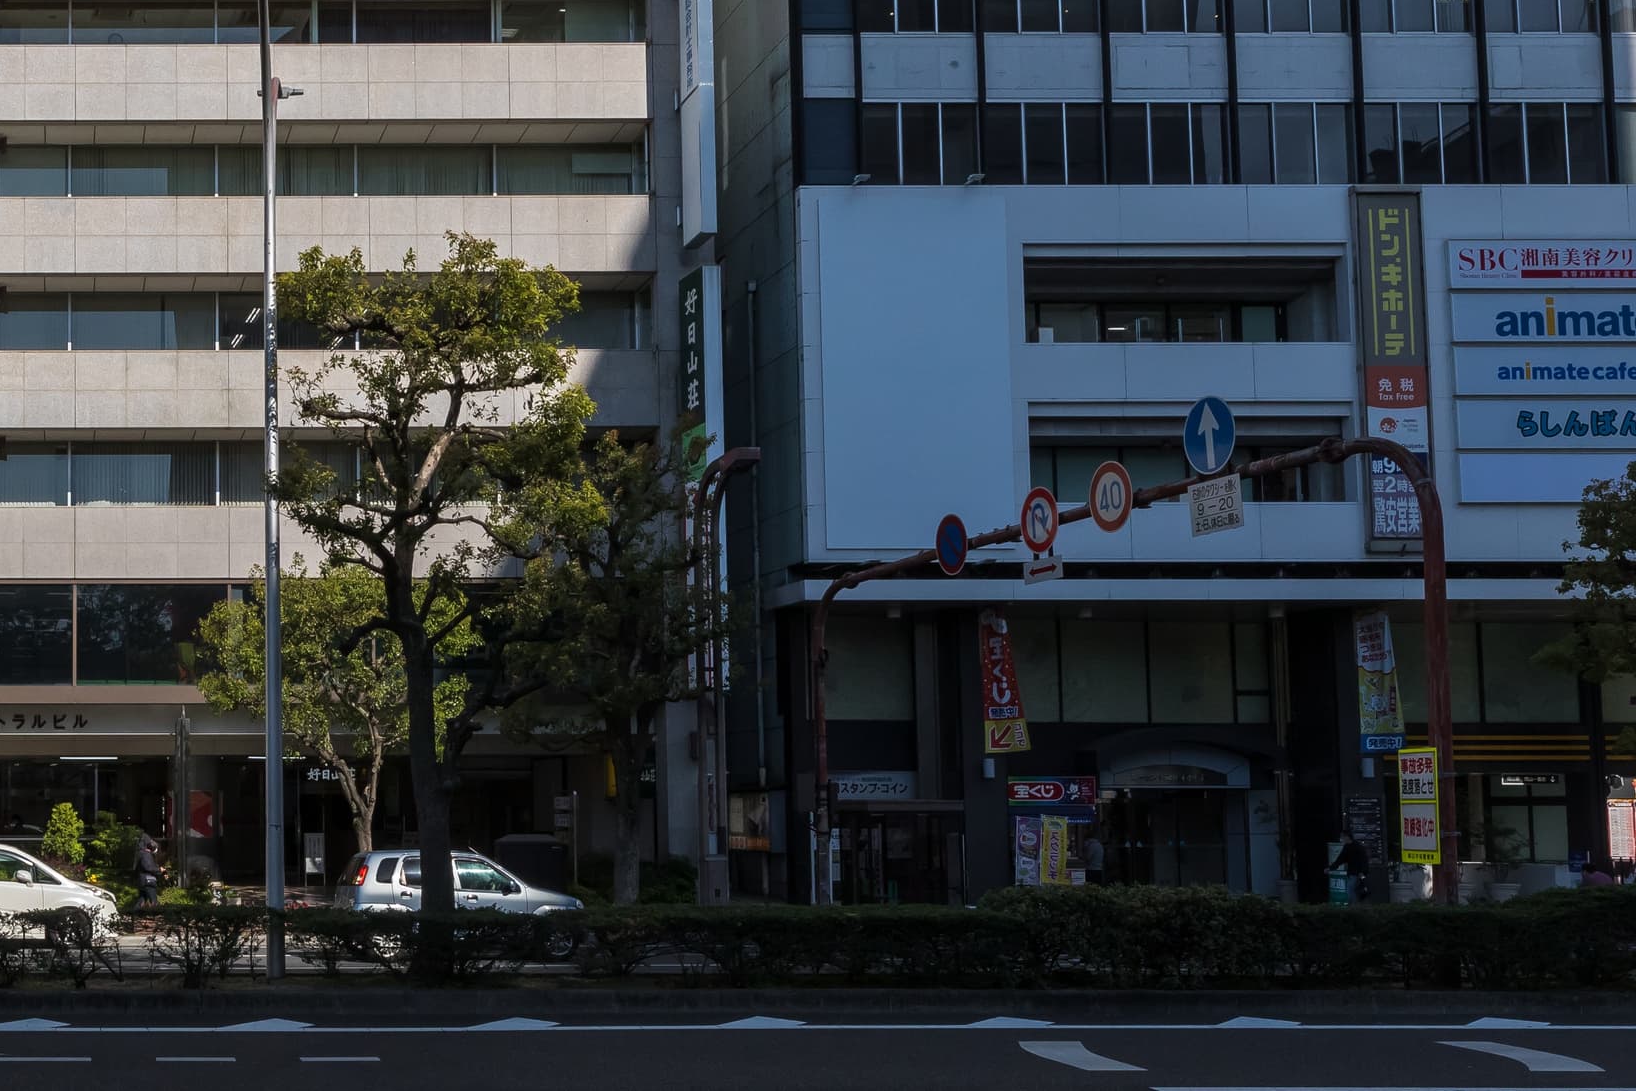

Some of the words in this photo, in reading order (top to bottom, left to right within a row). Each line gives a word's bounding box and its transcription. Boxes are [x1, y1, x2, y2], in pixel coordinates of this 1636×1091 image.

[1458, 248, 1518, 271] SBC
[1520, 247, 1633, 267] 湘南美容クリ
[1495, 296, 1636, 337] animat
[684, 287, 700, 411] 好日山荘
[1497, 362, 1590, 380] animate
[1378, 378, 1414, 392] 免税
[1378, 393, 1393, 401] Tax
[1396, 393, 1415, 401] Free
[1100, 480, 1123, 512] 40
[1401, 756, 1434, 775] 事故多発
